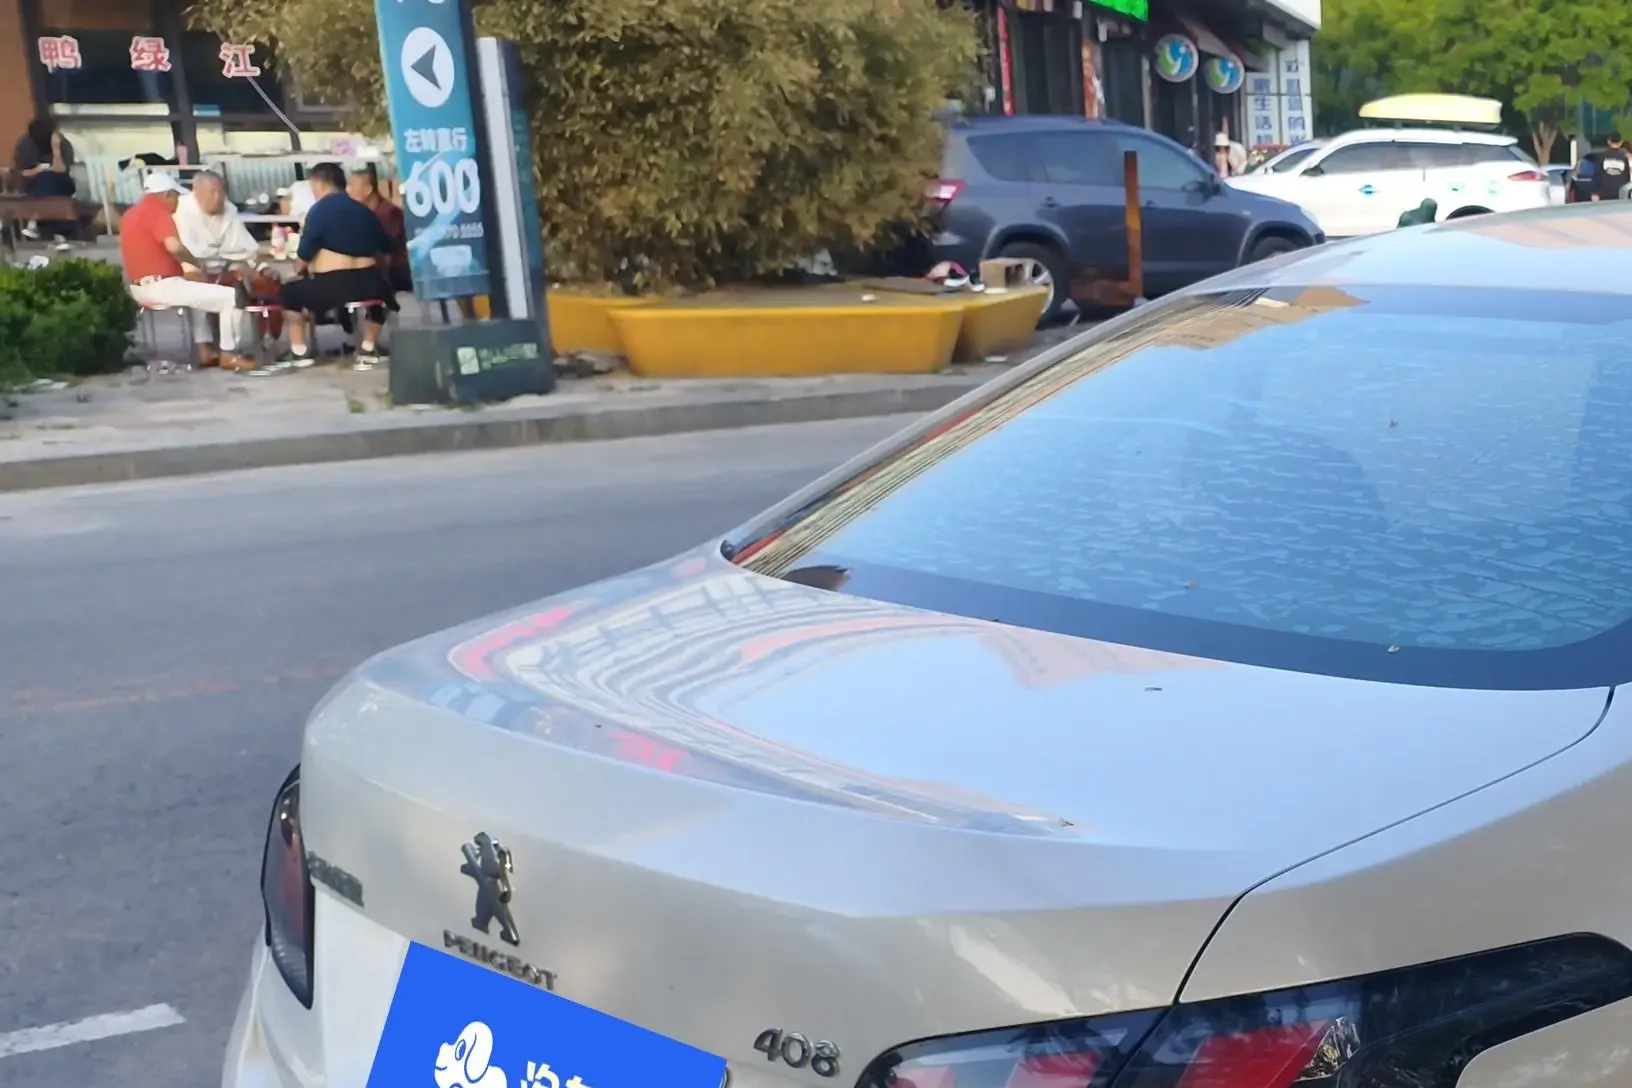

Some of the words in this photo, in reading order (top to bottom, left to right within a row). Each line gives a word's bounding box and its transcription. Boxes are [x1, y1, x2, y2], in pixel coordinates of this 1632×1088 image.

[38, 34, 261, 79] 鸭绿江
[404, 158, 481, 217] 600
[443, 929, 558, 991] PEUGEOT
[753, 1028, 841, 1078] 408
